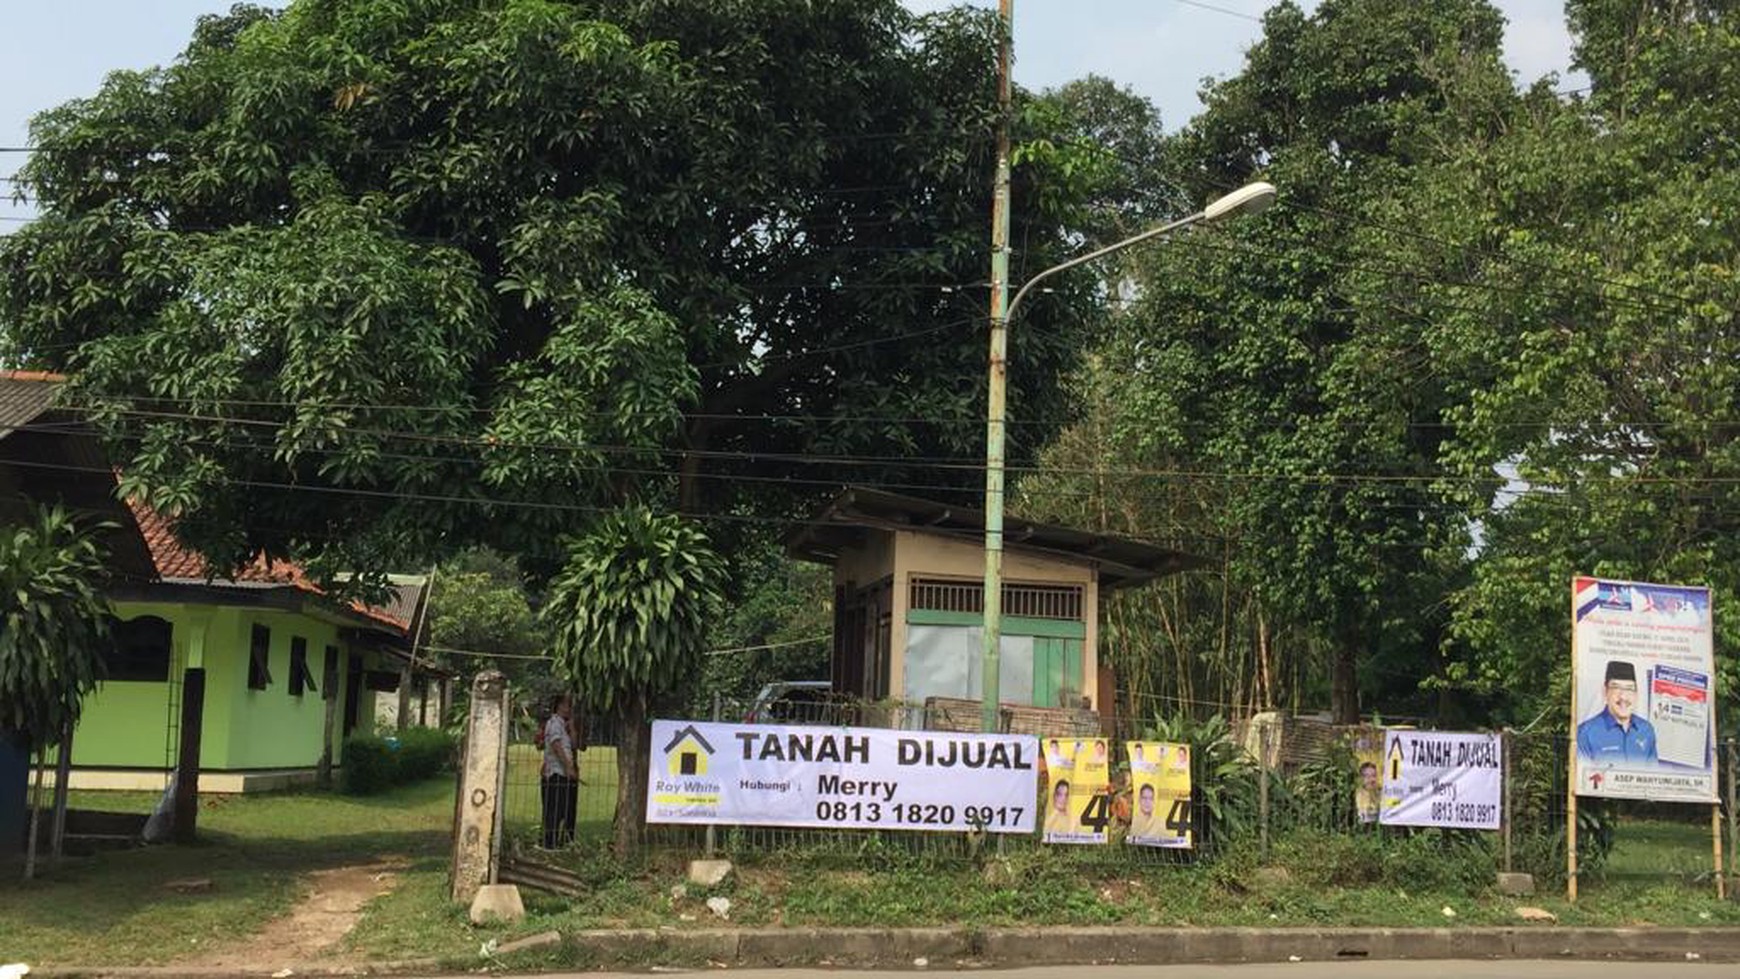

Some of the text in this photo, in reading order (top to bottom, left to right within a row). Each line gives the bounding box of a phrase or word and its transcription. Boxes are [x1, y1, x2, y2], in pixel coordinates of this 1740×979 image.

[735, 732, 1032, 770] TANAH DIJUAL
[1411, 740, 1498, 768] TANAH DIJUAL
[656, 781, 720, 794] Ray White
[740, 779, 791, 793] Hubungi
[818, 775, 898, 801] Merry
[1614, 773, 1634, 783] ASEP
[816, 801, 1024, 827] 0813 1820 9917
[1080, 794, 1109, 833] 4
[1166, 799, 1191, 837] 4
[1431, 802, 1496, 823] 0813 1820 9917
